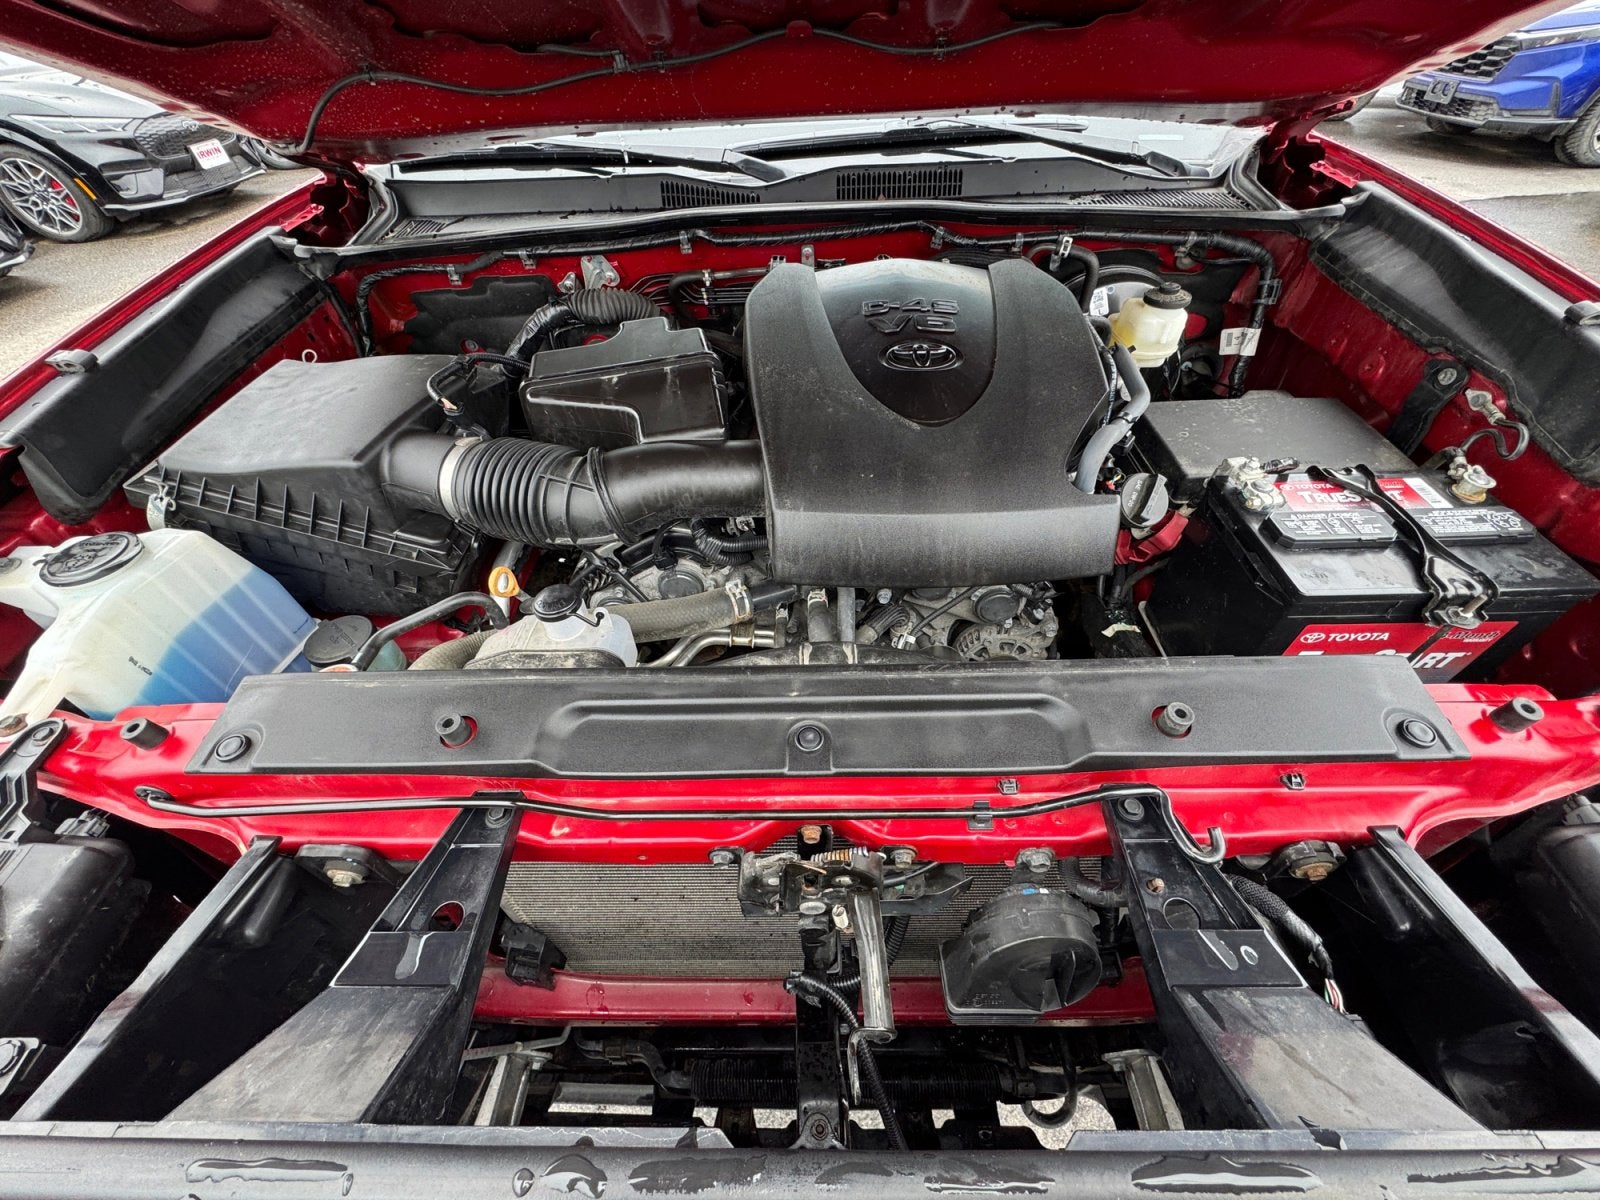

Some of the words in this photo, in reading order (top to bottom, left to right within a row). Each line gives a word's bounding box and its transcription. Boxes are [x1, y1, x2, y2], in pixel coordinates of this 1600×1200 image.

[197, 146, 222, 160] IRWIN
[862, 298, 959, 316] D-4S
[866, 314, 957, 333] V6
[1327, 632, 1390, 643] TOYOTA
